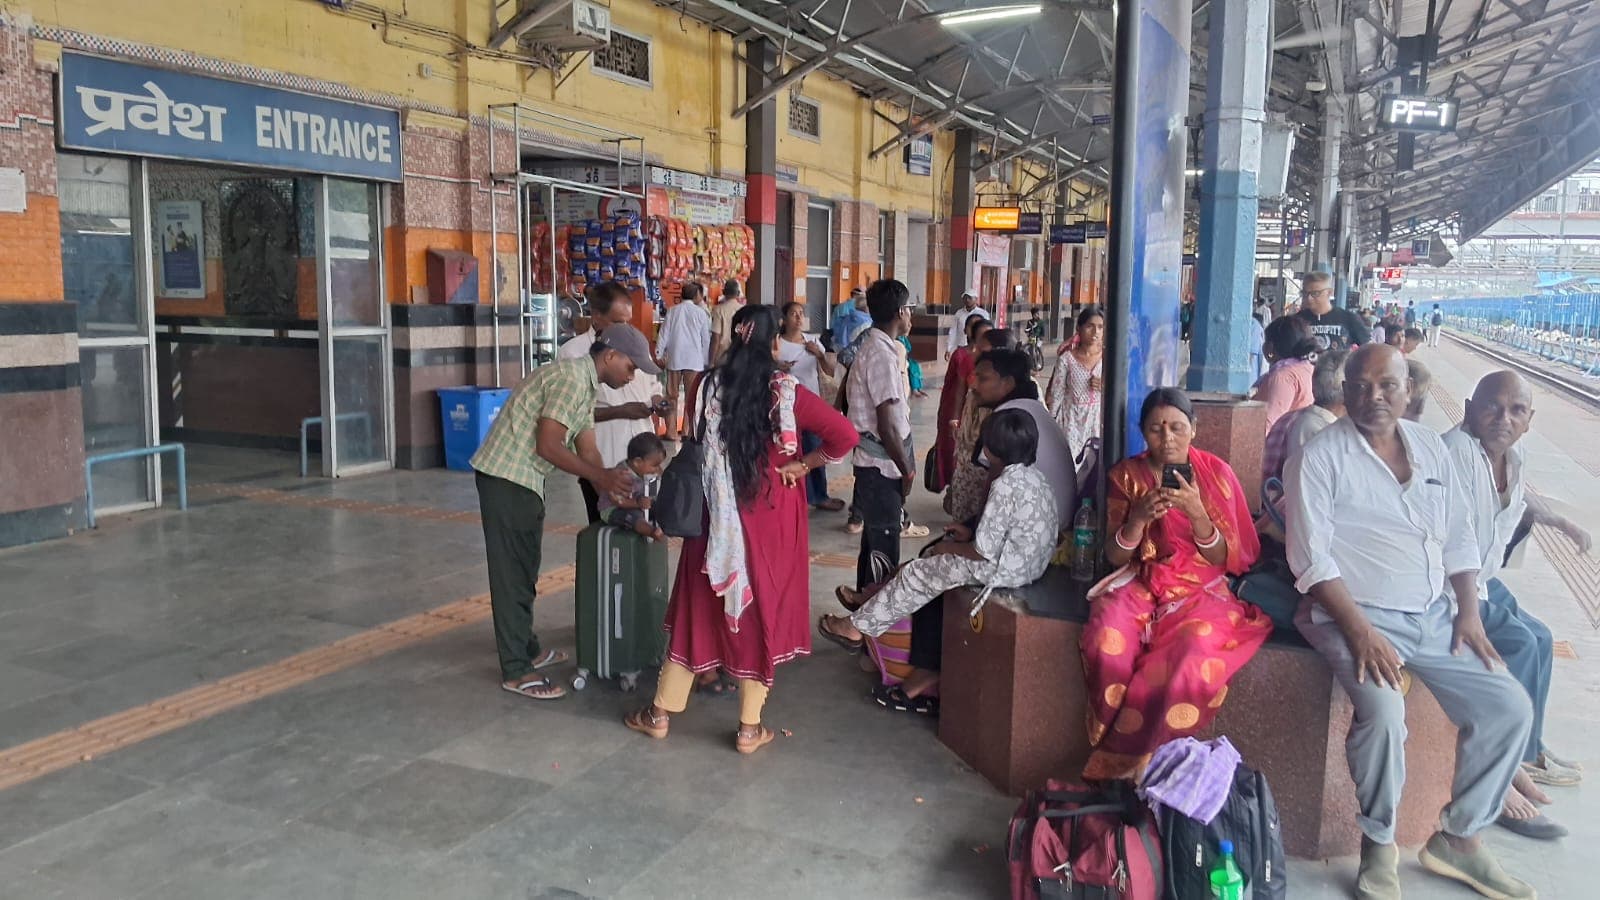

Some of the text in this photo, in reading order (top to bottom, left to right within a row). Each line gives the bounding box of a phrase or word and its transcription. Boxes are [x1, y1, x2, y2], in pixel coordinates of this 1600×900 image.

[75, 80, 228, 143] प्रवेश
[255, 105, 392, 164] ENTRANCE
[1390, 99, 1449, 127] PF-1
